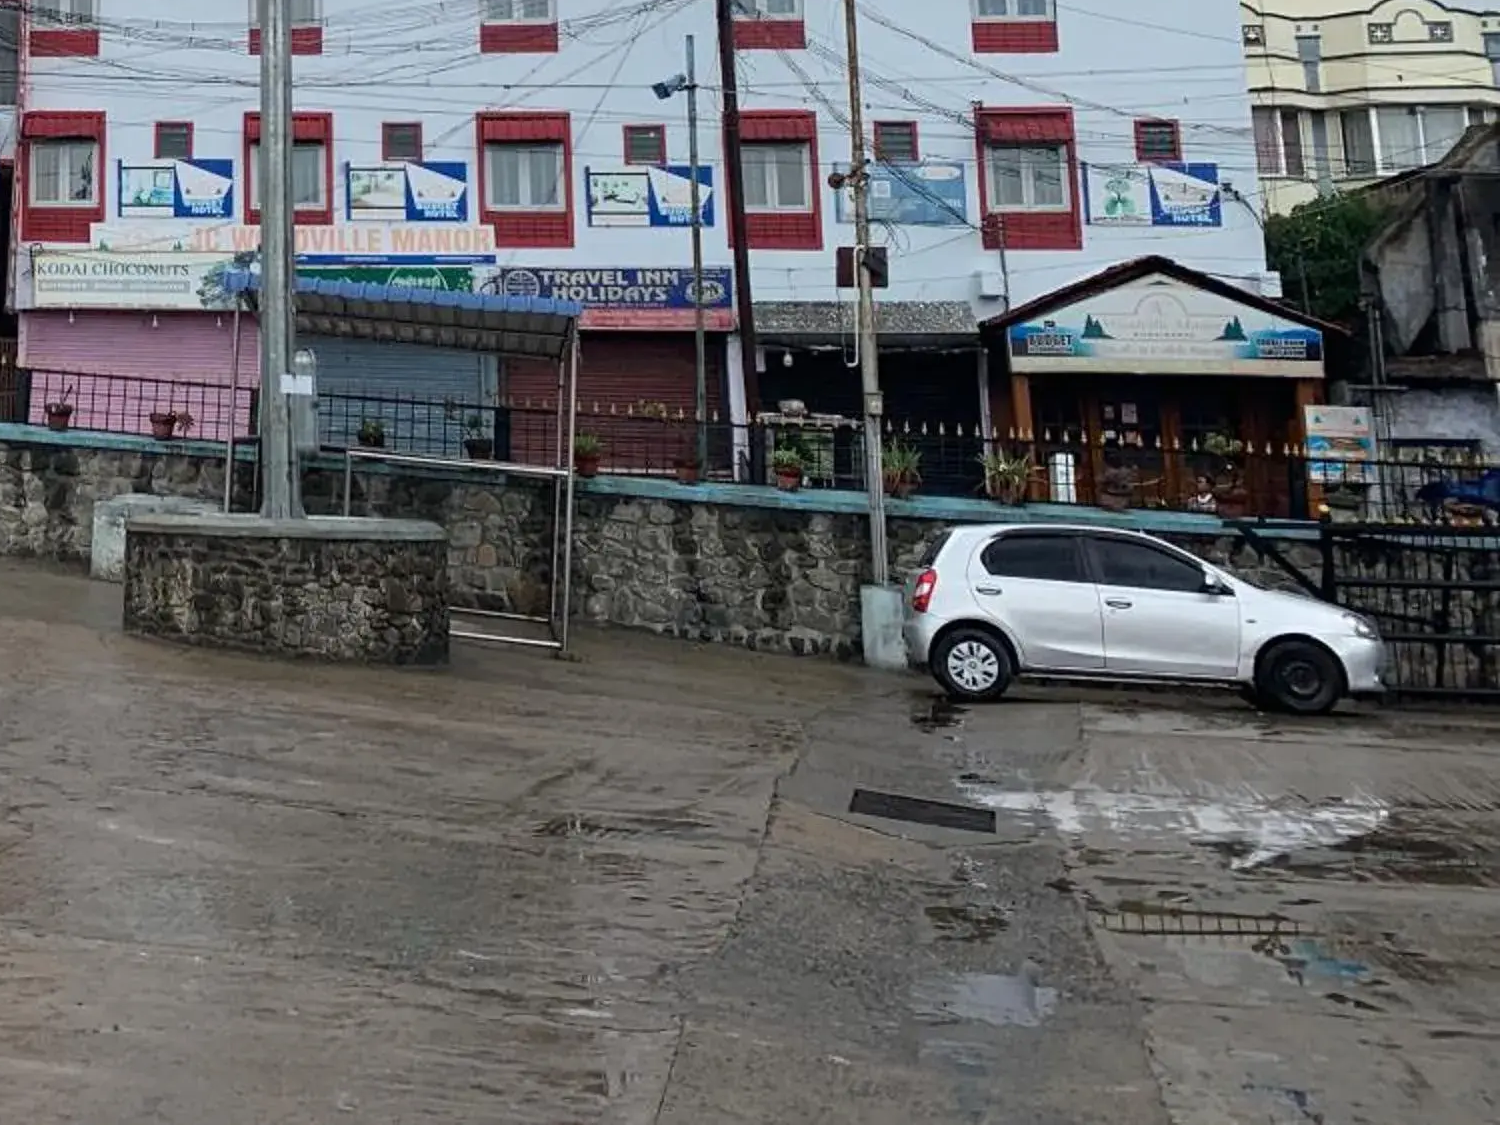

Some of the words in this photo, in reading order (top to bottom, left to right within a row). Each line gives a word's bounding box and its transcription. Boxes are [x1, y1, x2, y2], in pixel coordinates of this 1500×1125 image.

[1172, 214, 1213, 223] HOTEL
[390, 228, 490, 252] MANOR
[37, 262, 88, 276] KODAI
[91, 262, 190, 277] CHOCONUTS
[537, 270, 629, 286] TRAVEL
[636, 271, 679, 286] INN
[551, 286, 668, 302] HOLIDAYS
[1028, 334, 1073, 346] BUDGET
